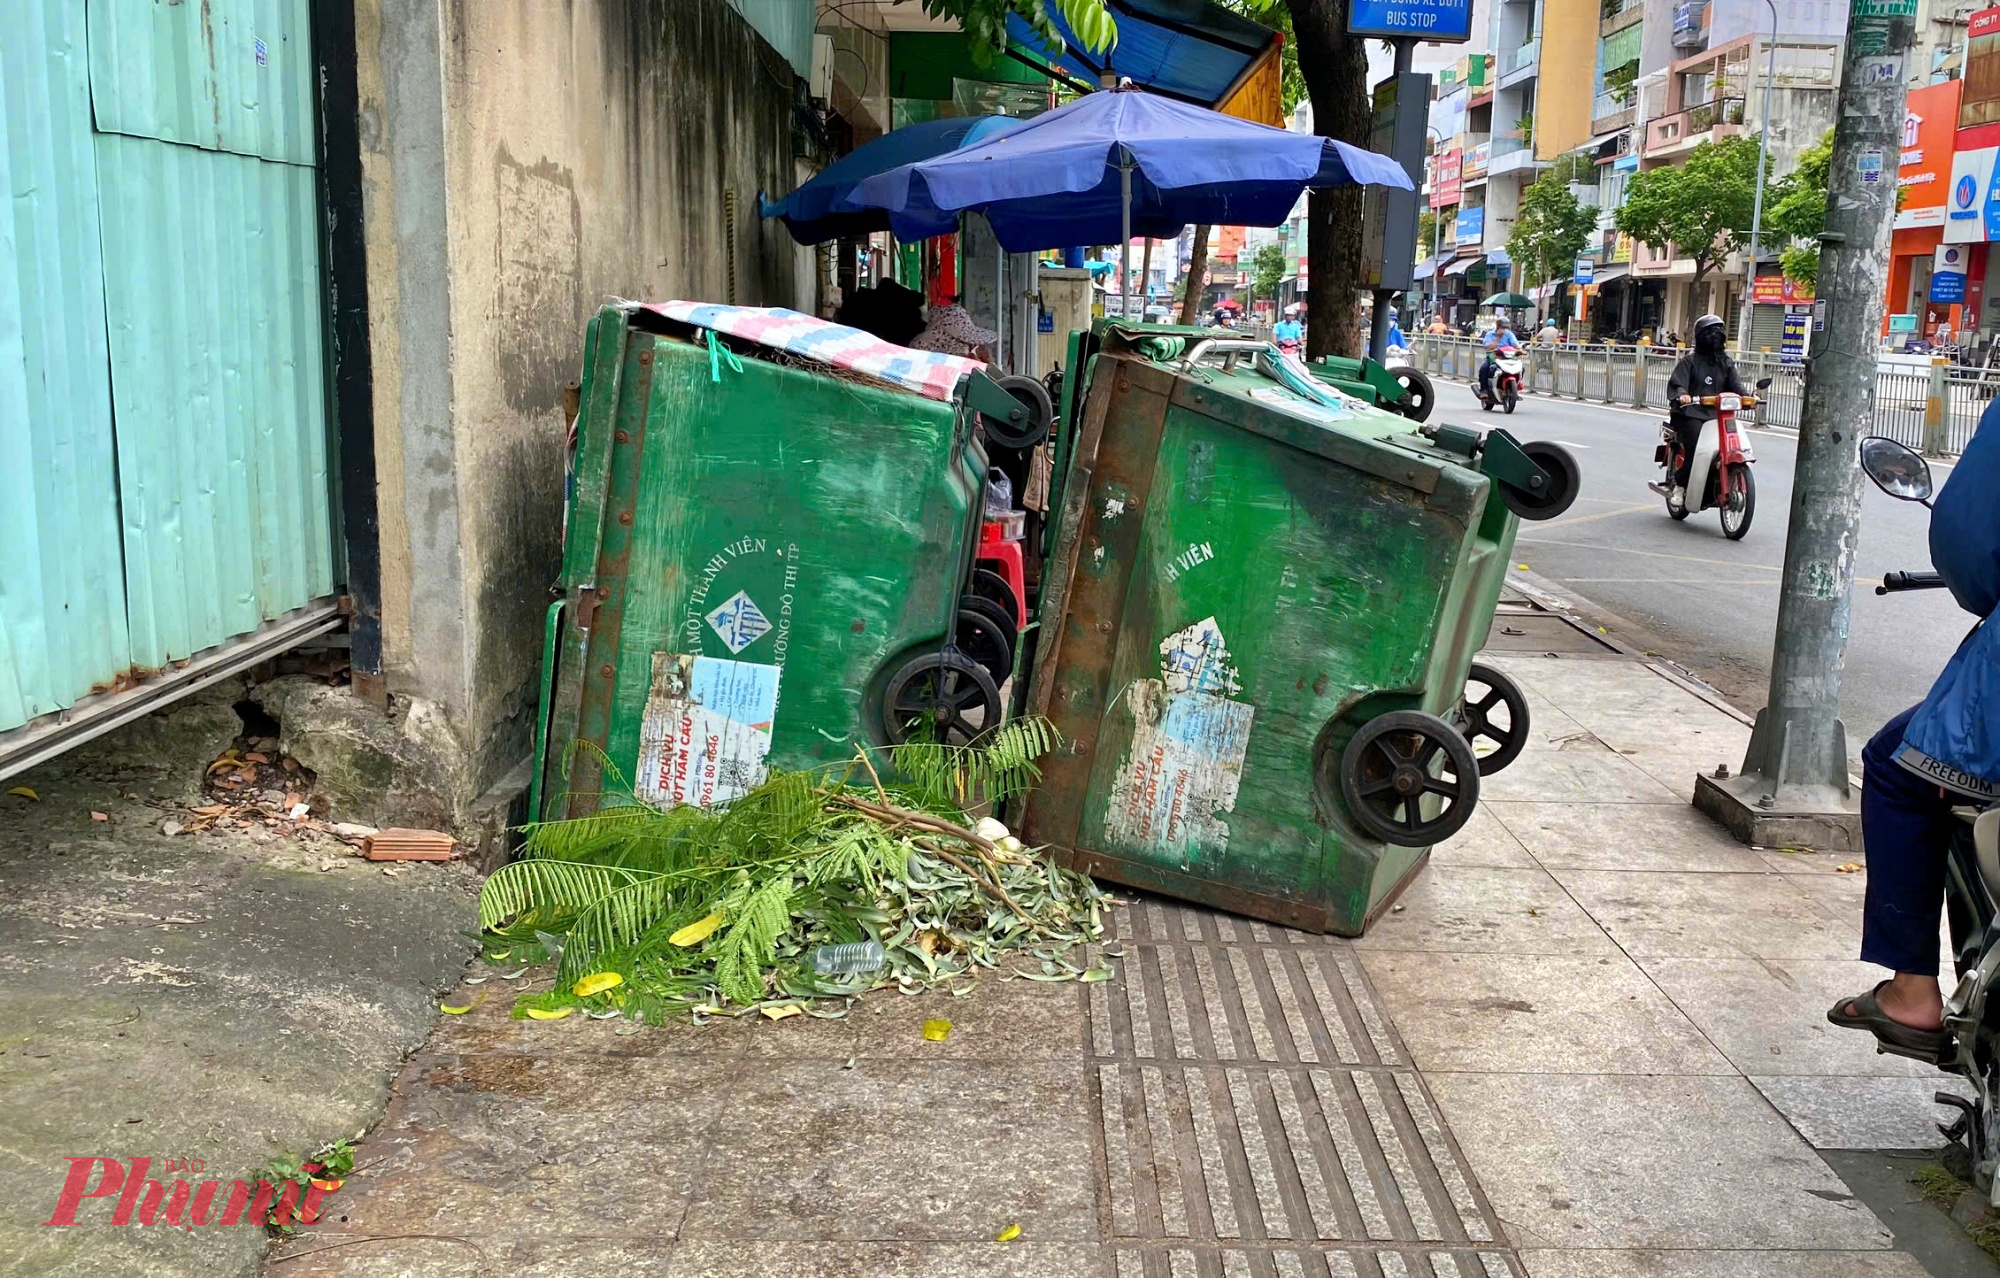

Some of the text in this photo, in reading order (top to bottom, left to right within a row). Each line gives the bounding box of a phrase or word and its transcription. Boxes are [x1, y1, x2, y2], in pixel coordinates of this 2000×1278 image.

[1387, 11, 1437, 27] BUS STOP
[724, 534, 766, 558] VIÊN
[787, 543, 799, 561] TP
[1177, 541, 1214, 571] VIÊN
[784, 565, 800, 590] THỊ
[780, 594, 793, 616] ĐÔ
[705, 734, 719, 762] 4646
[703, 764, 715, 778] 80
[1171, 797, 1182, 812] 80
